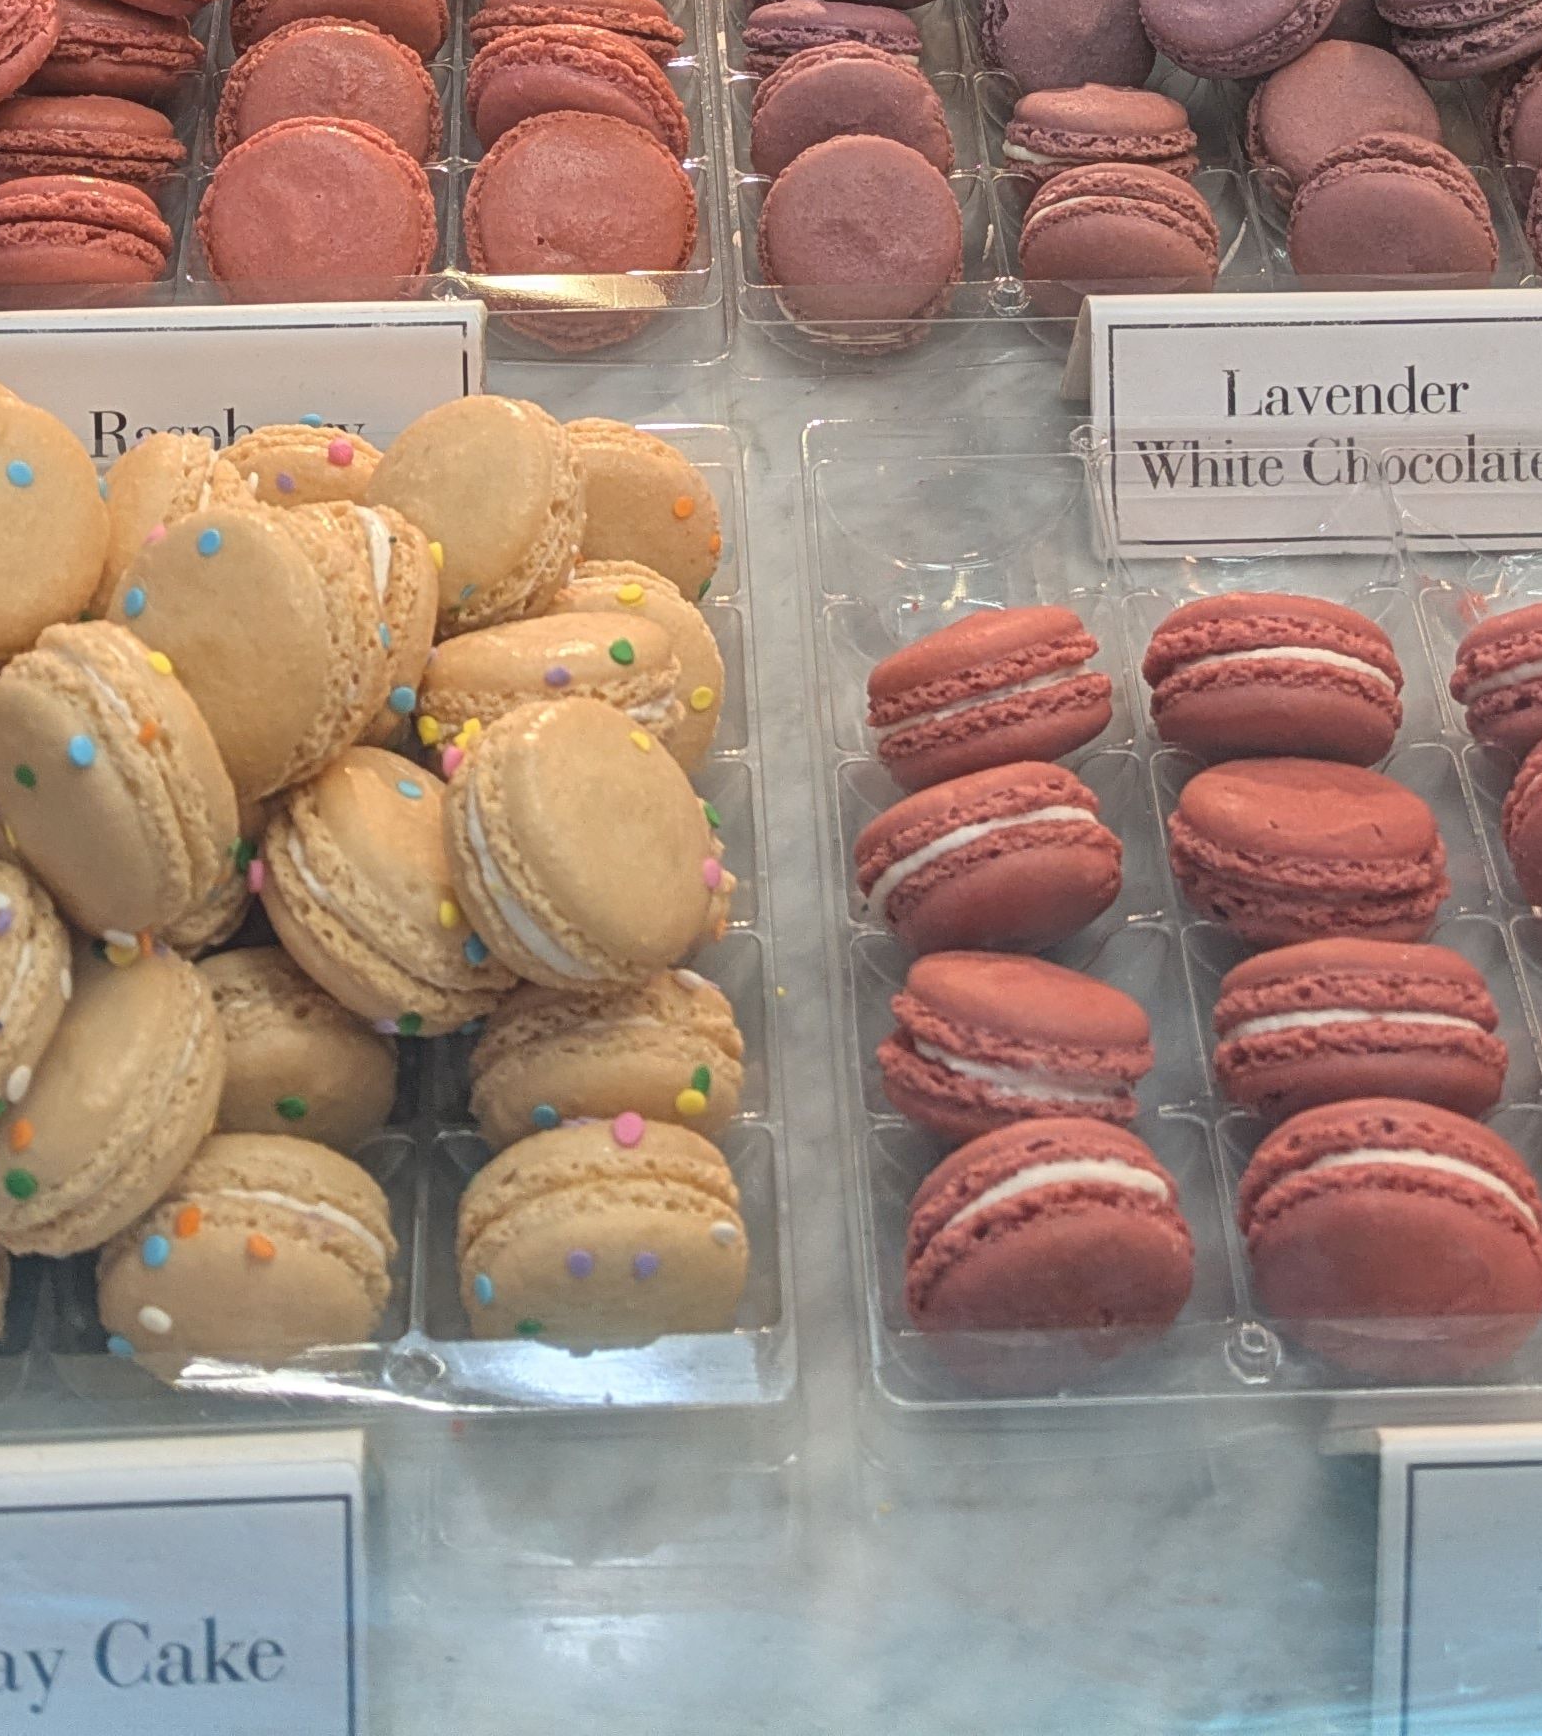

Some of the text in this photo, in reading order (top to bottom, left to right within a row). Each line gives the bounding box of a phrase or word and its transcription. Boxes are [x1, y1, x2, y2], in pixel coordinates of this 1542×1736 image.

[1222, 365, 1469, 417] Lavender
[1132, 438, 1285, 489] White
[95, 1616, 286, 1689] Cake
